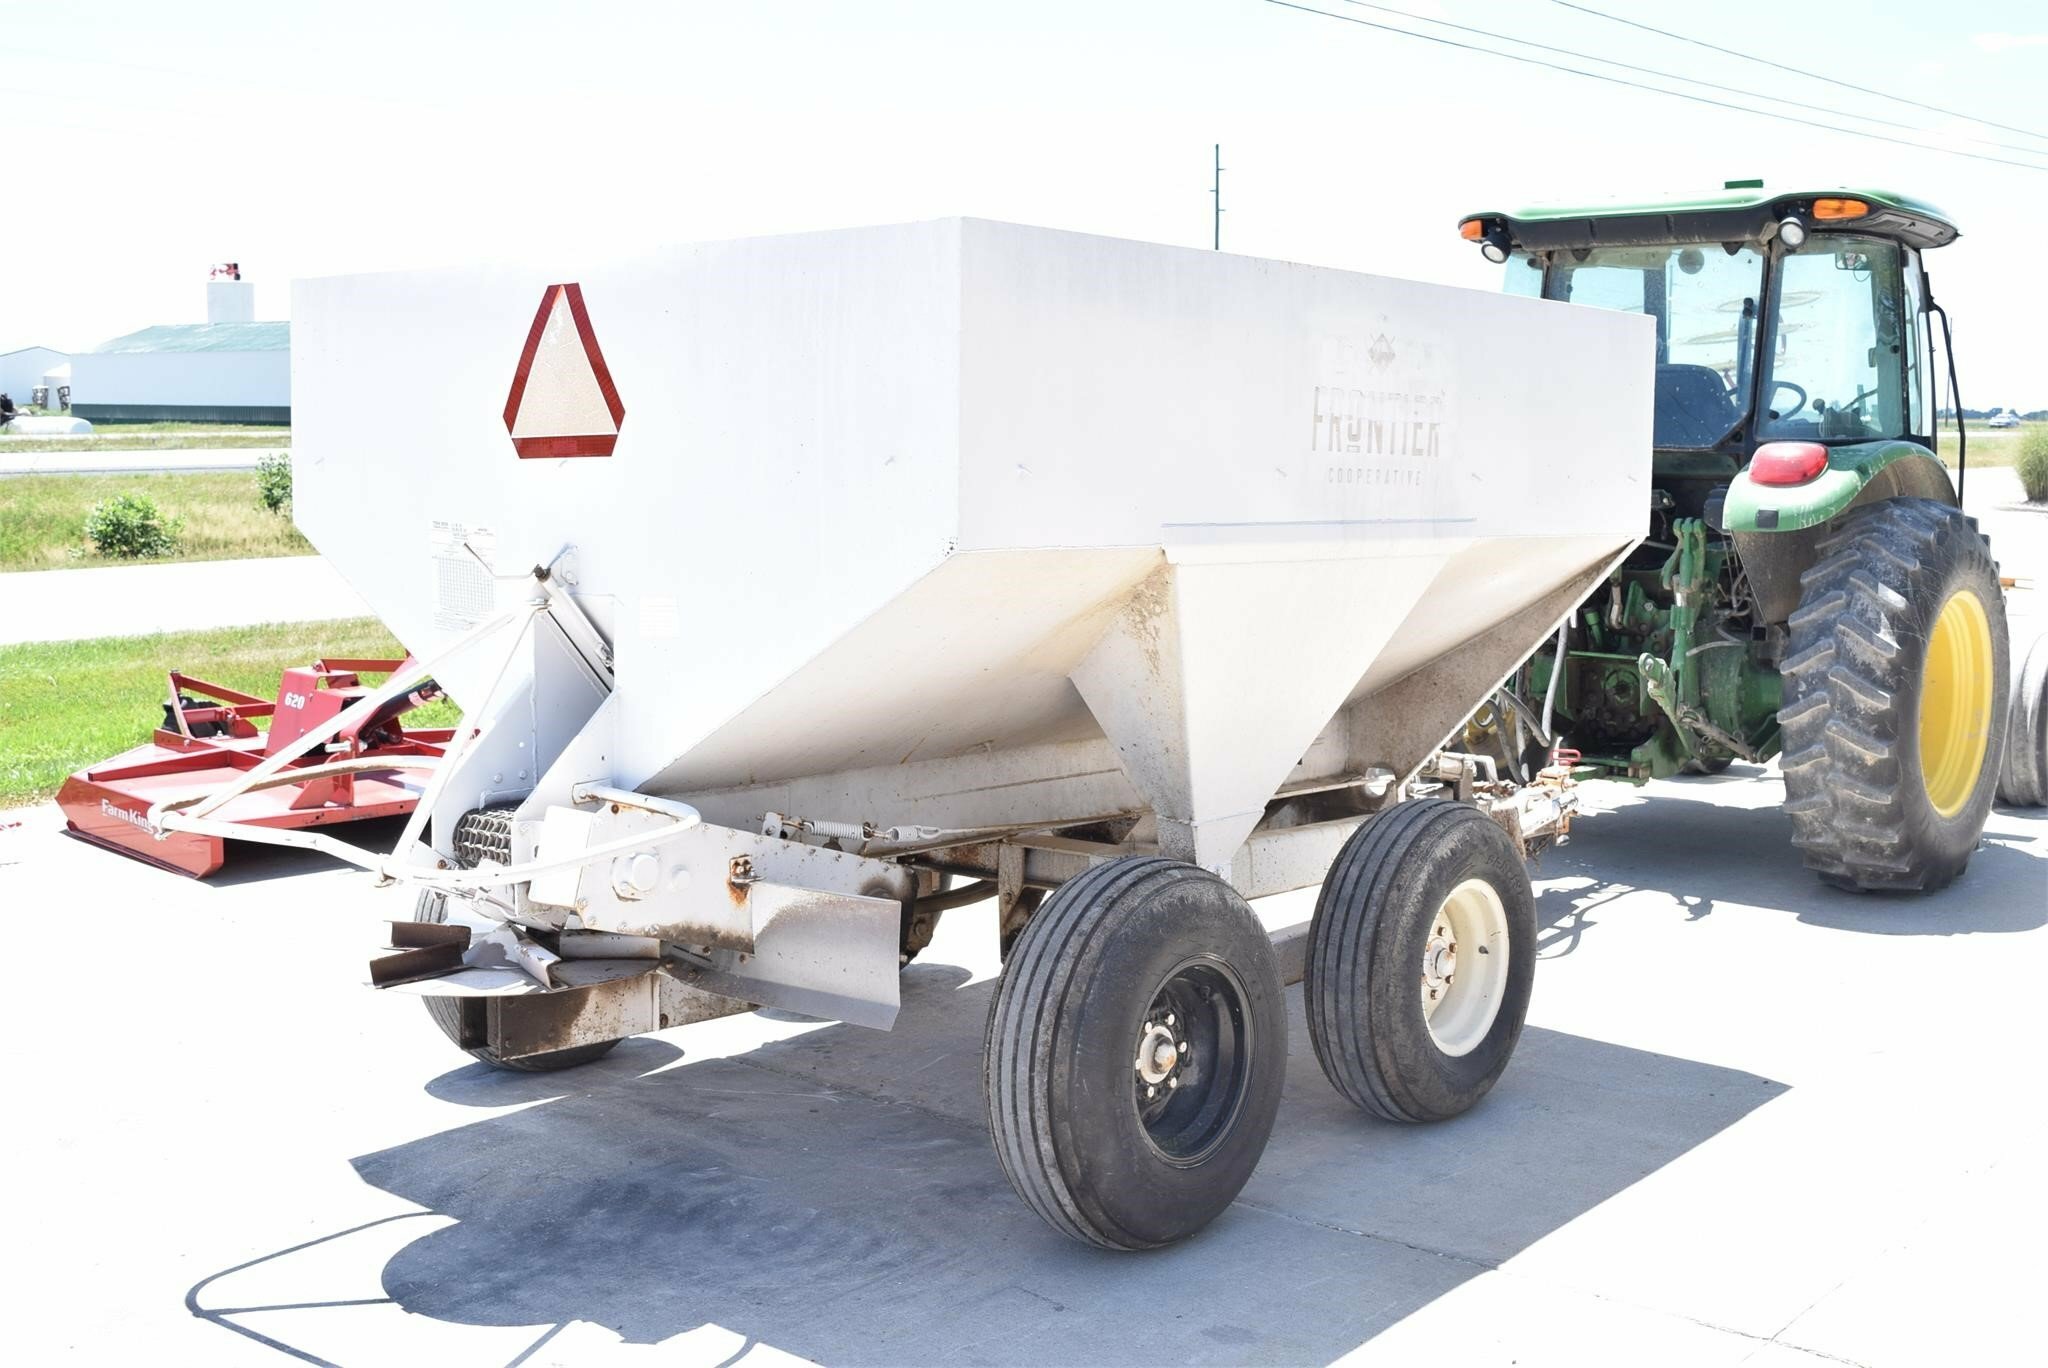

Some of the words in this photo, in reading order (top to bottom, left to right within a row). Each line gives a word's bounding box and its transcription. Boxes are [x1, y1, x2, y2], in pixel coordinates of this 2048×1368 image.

[1312, 386, 1445, 457] FRONTIER
[1328, 467, 1421, 486] COOPERATIVE
[285, 691, 306, 710] 620
[102, 798, 128, 821] Farm
